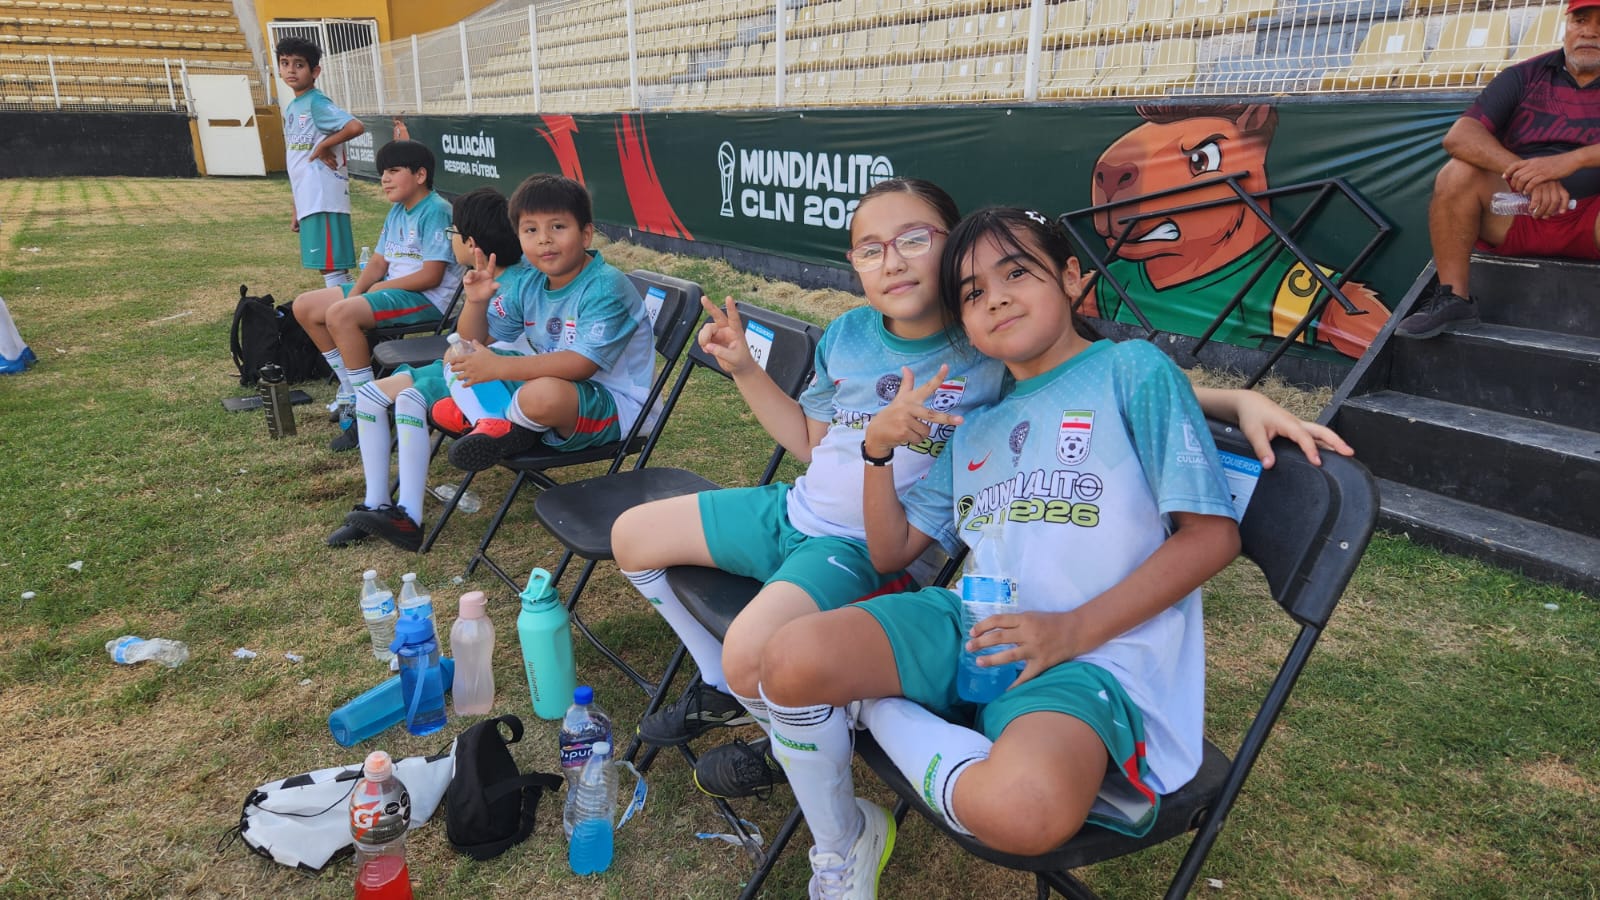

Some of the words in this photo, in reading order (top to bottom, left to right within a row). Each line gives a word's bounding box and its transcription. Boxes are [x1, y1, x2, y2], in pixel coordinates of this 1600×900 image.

[442, 130, 496, 158] CULIACÁN
[444, 160, 472, 175] RESPIRA
[471, 160, 500, 179] FÚTBOL
[740, 149, 894, 195] MUNDIALITO
[741, 188, 795, 223] CLN
[1219, 454, 1261, 473] ZQUIERDO
[1008, 498, 1099, 527] 2026
